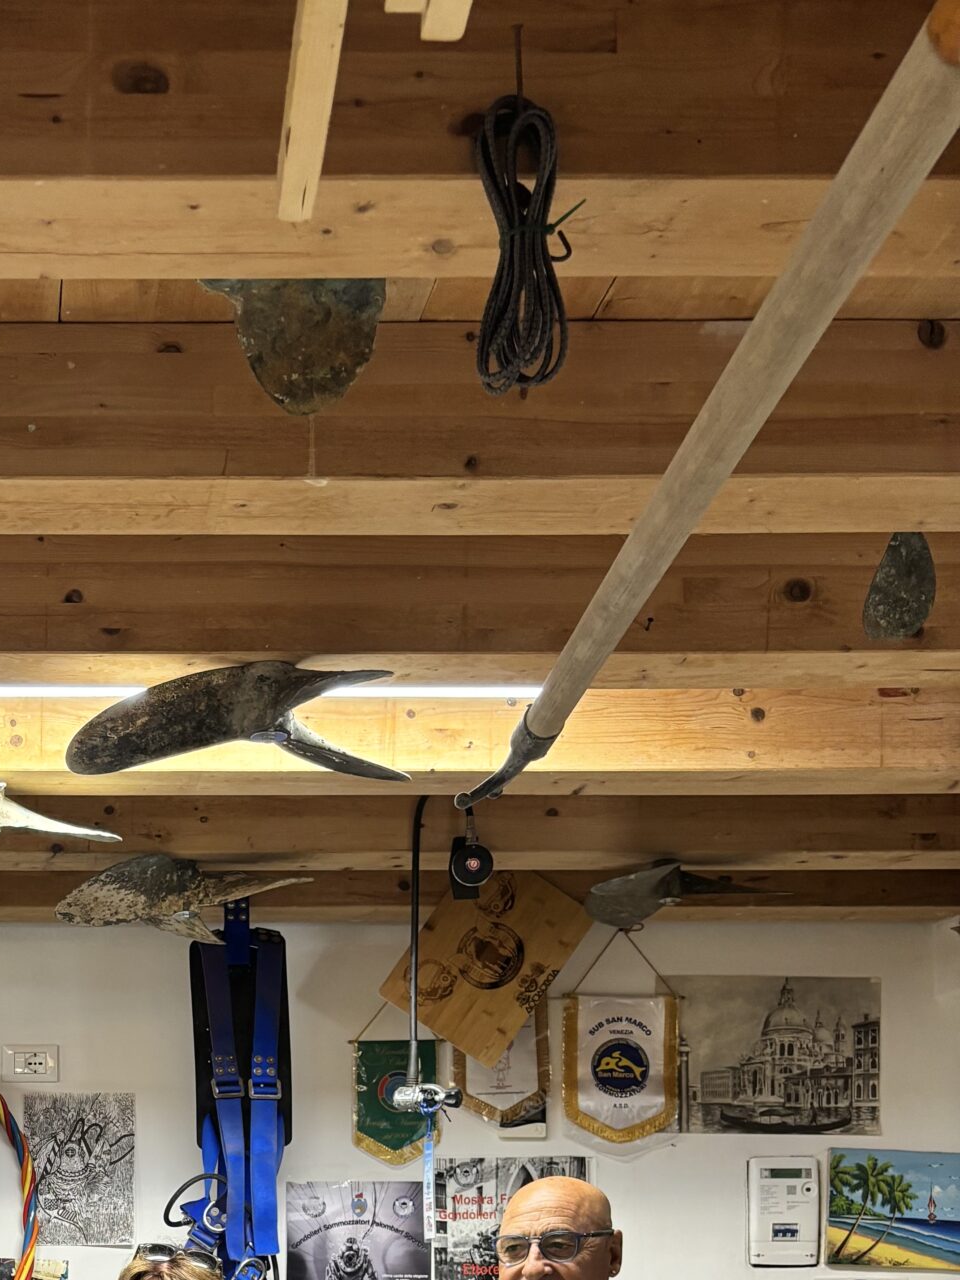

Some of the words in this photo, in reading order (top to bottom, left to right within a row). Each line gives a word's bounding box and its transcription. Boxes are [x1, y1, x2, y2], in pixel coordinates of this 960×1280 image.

[589, 1021, 604, 1036] SUB
[605, 1016, 623, 1025] SAN
[625, 1016, 652, 1036] MARCO
[453, 1194, 493, 1206] Mostra
[439, 1210, 497, 1221] Gondolieri
[291, 1227, 323, 1249] Gondolieri
[323, 1219, 370, 1231] Sommozzatori
